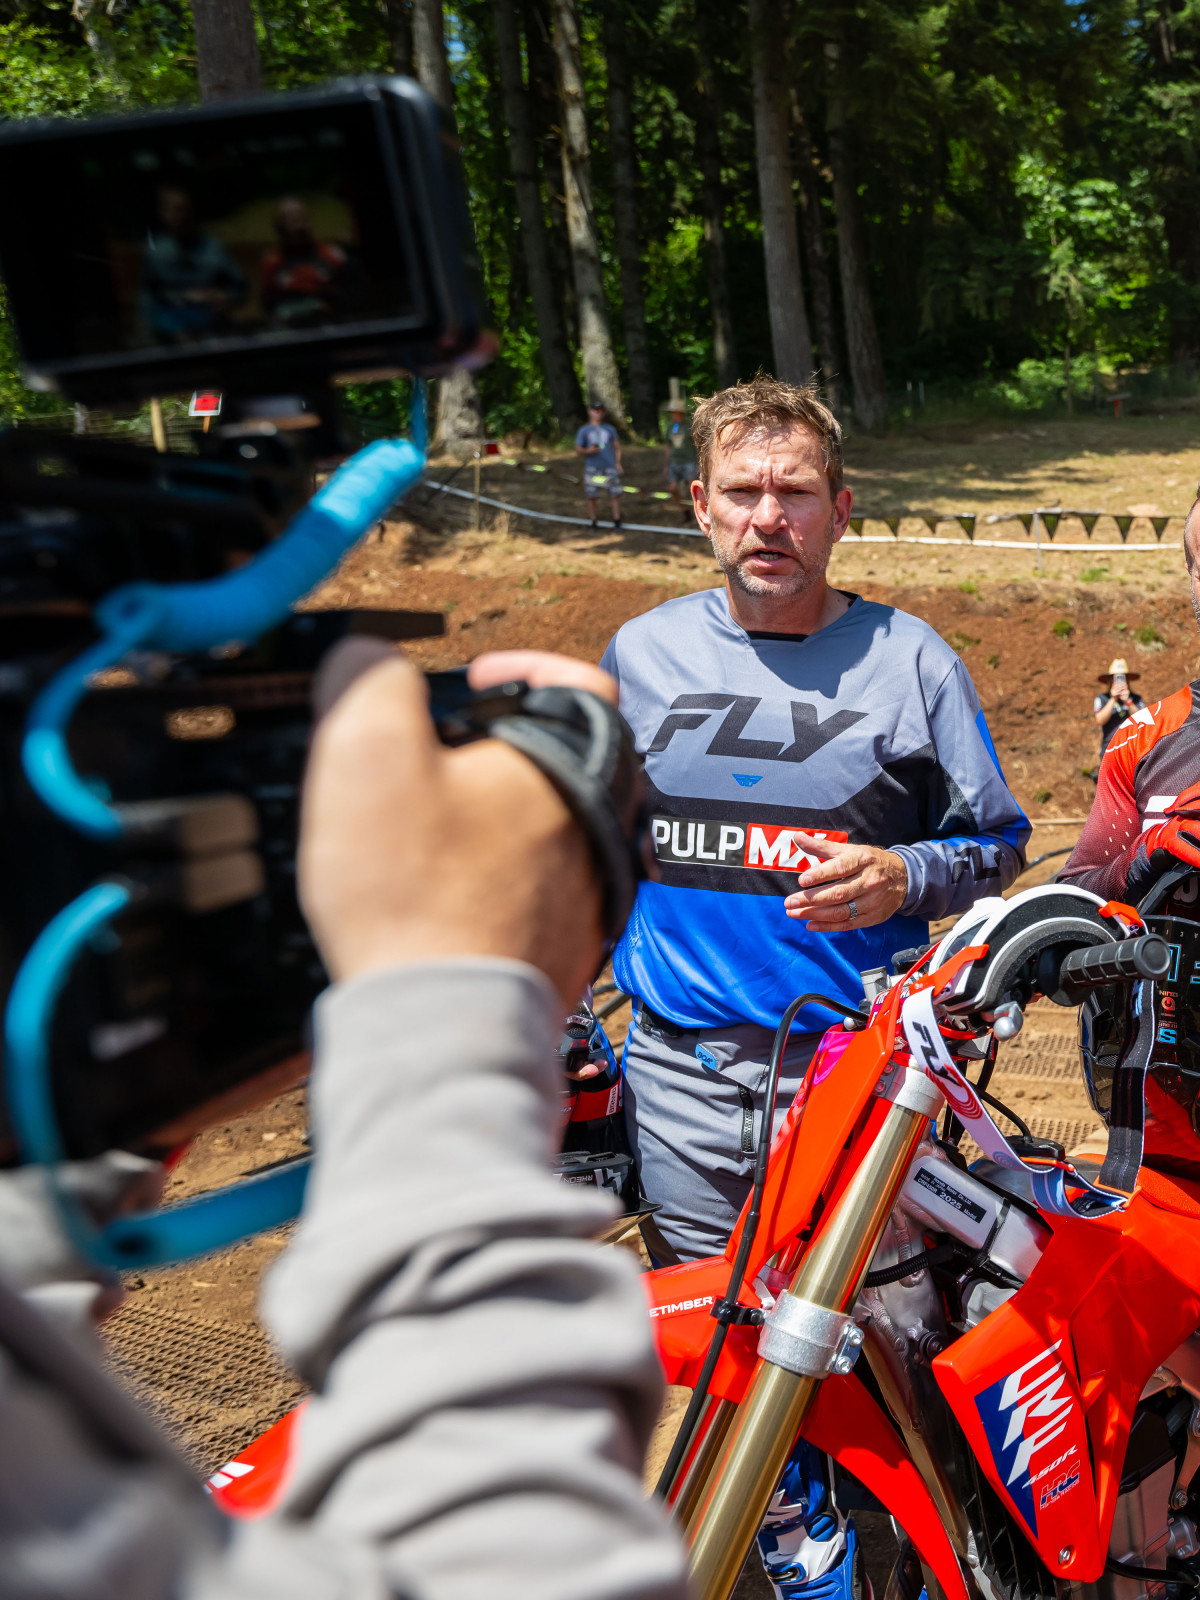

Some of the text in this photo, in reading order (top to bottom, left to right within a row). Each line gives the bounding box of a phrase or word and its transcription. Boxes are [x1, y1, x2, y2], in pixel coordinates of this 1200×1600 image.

[647, 693, 869, 763] FLY
[939, 1191, 963, 1210] 2025
[998, 1338, 1074, 1487] CRF
